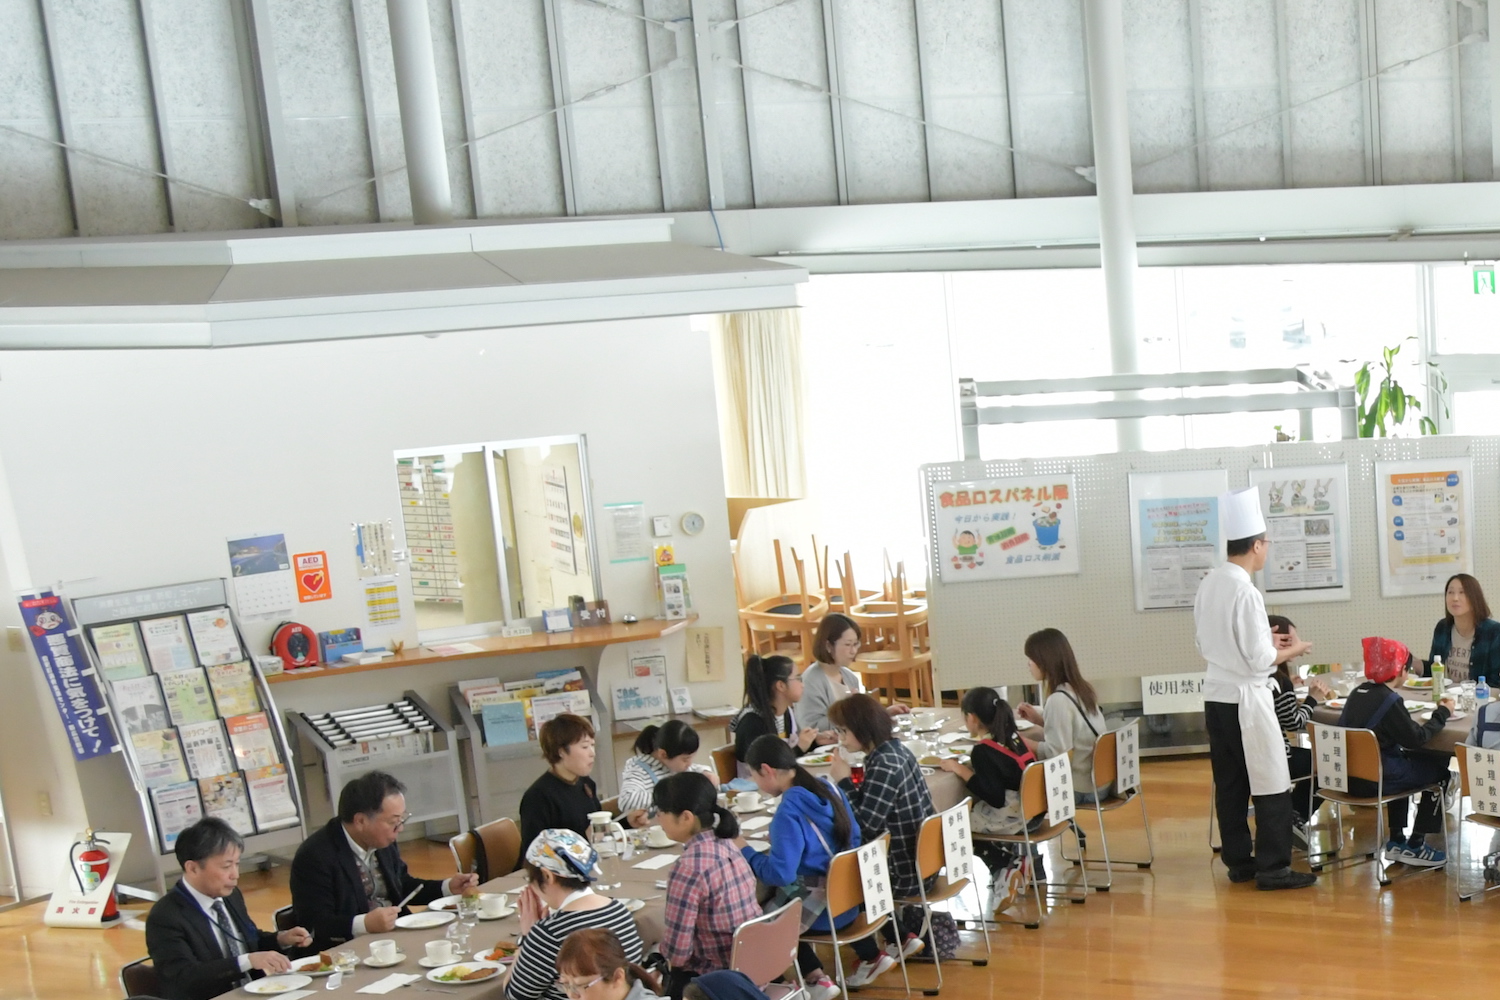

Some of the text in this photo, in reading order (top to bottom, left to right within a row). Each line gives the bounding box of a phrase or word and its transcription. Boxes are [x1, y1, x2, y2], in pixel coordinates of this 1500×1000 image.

[939, 484, 1069, 509] 食品ロスパネル展
[234, 565, 243, 576] 2
[302, 557, 319, 566] AED
[1321, 730, 1331, 787] 参加者
[1332, 730, 1343, 788] 料理教室
[1473, 752, 1485, 812] 参加者
[1486, 753, 1498, 813] 料理教室
